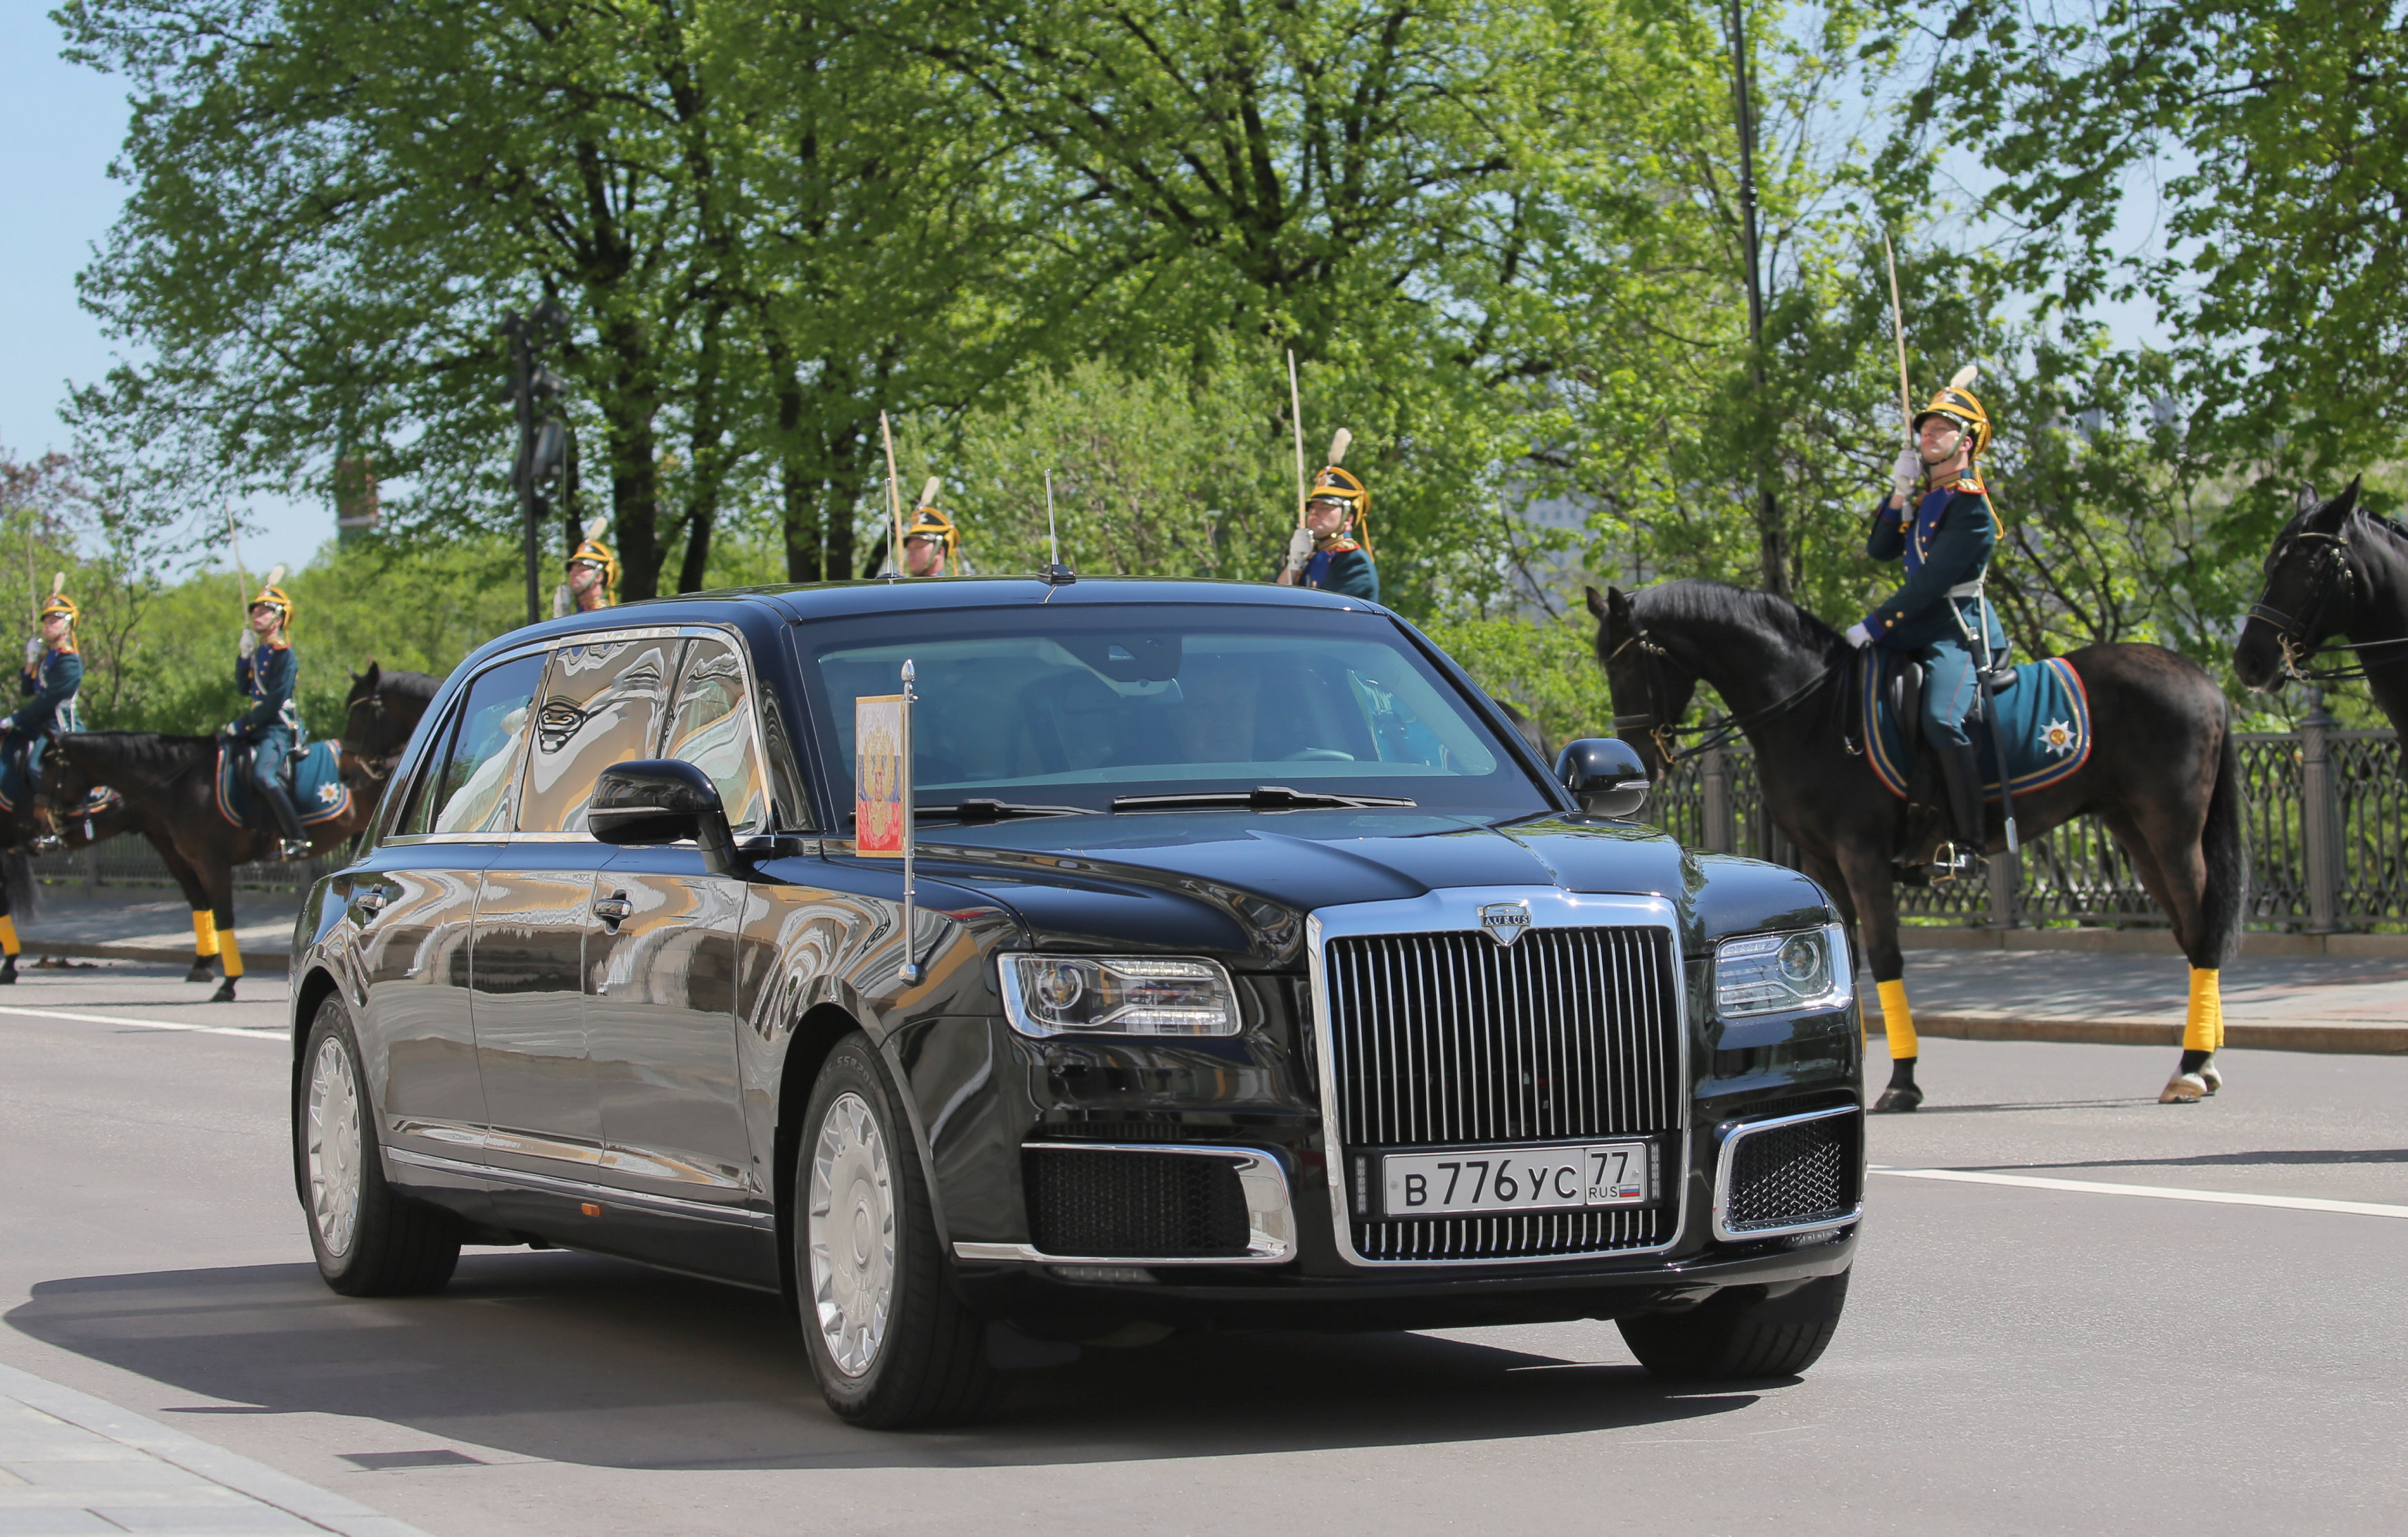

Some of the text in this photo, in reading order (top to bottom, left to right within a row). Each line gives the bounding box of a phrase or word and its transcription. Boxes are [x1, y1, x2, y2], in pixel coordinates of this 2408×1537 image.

[1485, 916, 1529, 926] AURUS
[1590, 1151, 1629, 1185] 77
[1589, 1187, 1618, 1199] RUS
